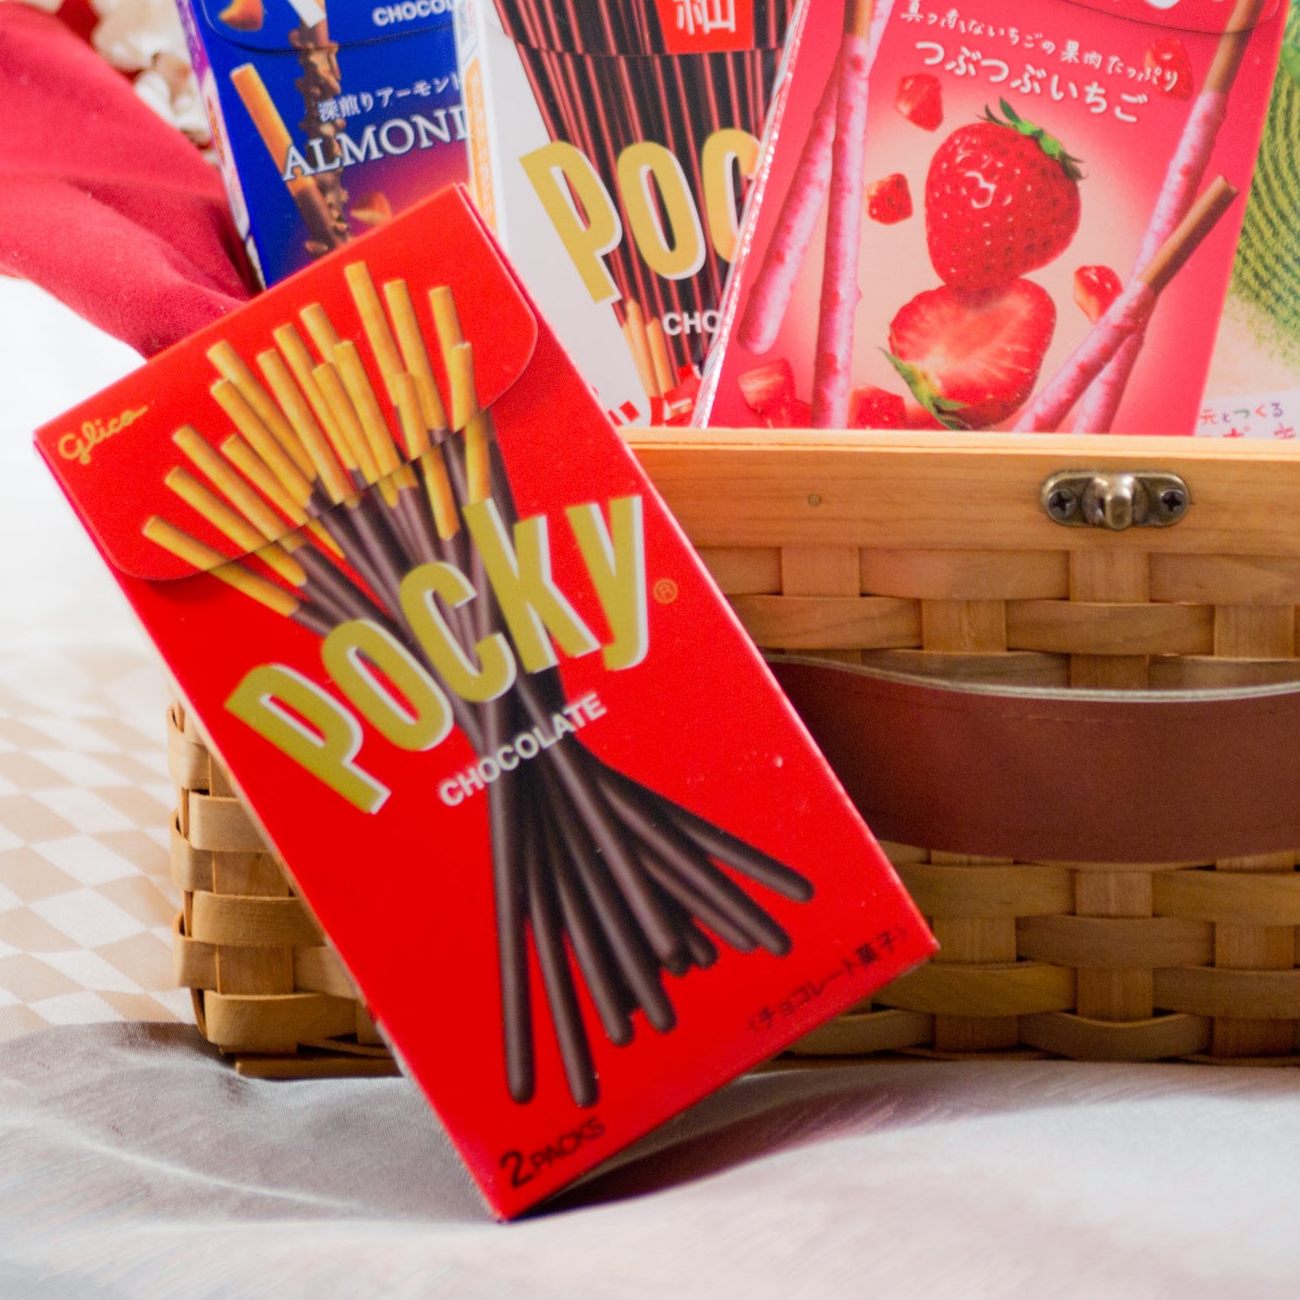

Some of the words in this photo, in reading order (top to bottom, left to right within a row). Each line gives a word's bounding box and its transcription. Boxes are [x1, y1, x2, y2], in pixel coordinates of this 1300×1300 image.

[915, 42, 1148, 122] つぶつぶいちご
[58, 405, 149, 465] Glico
[225, 495, 650, 815] Pocky
[438, 692, 607, 806] CHOCOLATE
